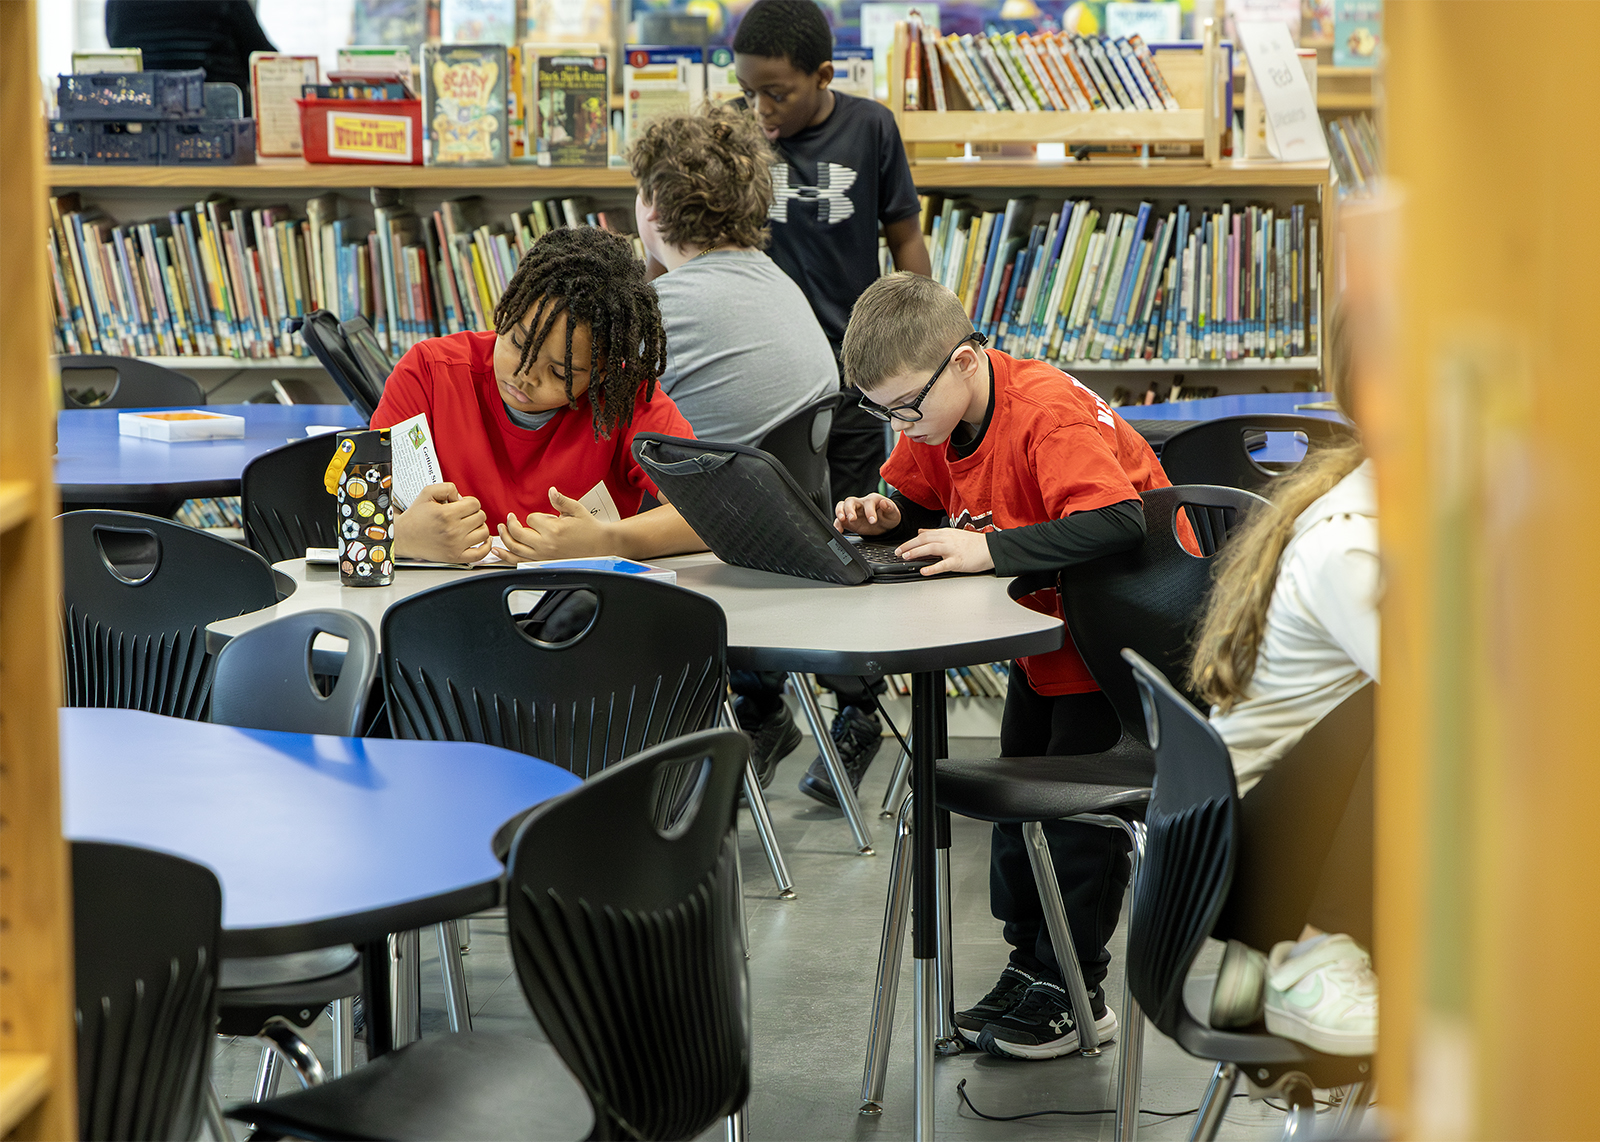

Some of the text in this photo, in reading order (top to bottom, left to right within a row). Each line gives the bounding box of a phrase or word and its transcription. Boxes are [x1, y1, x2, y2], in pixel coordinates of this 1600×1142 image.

[443, 69, 489, 92] SCARY
[336, 127, 373, 147] WOULD
[423, 446, 434, 475] Getting
